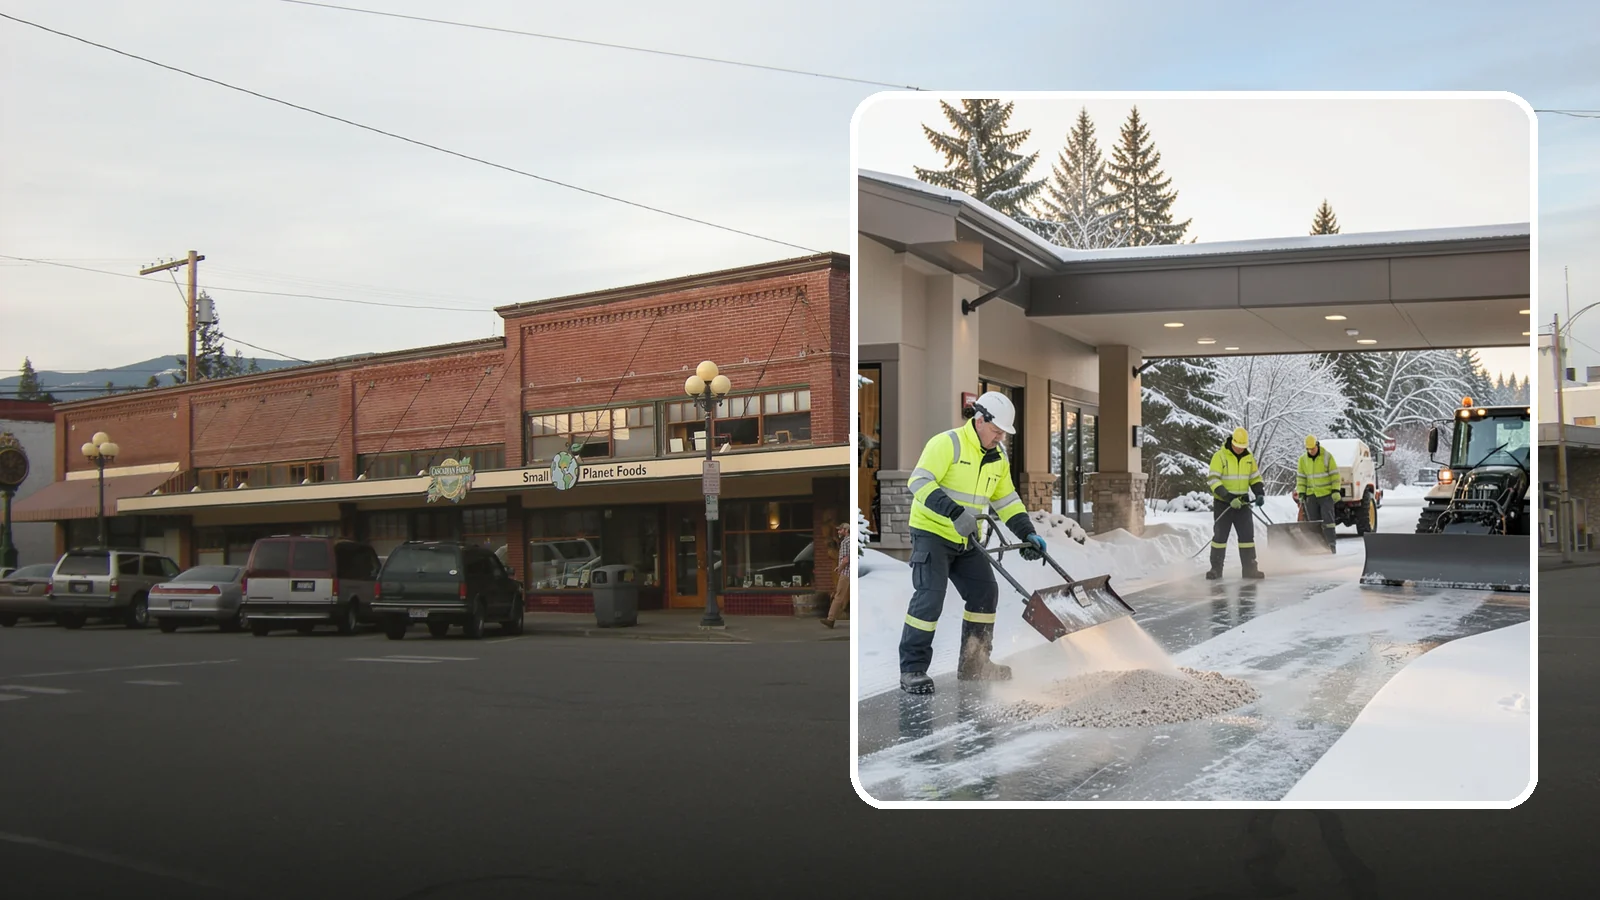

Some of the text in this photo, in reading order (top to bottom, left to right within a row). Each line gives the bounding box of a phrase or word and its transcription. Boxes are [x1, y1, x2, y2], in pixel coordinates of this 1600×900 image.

[523, 464, 647, 483] Small Planet Foods
